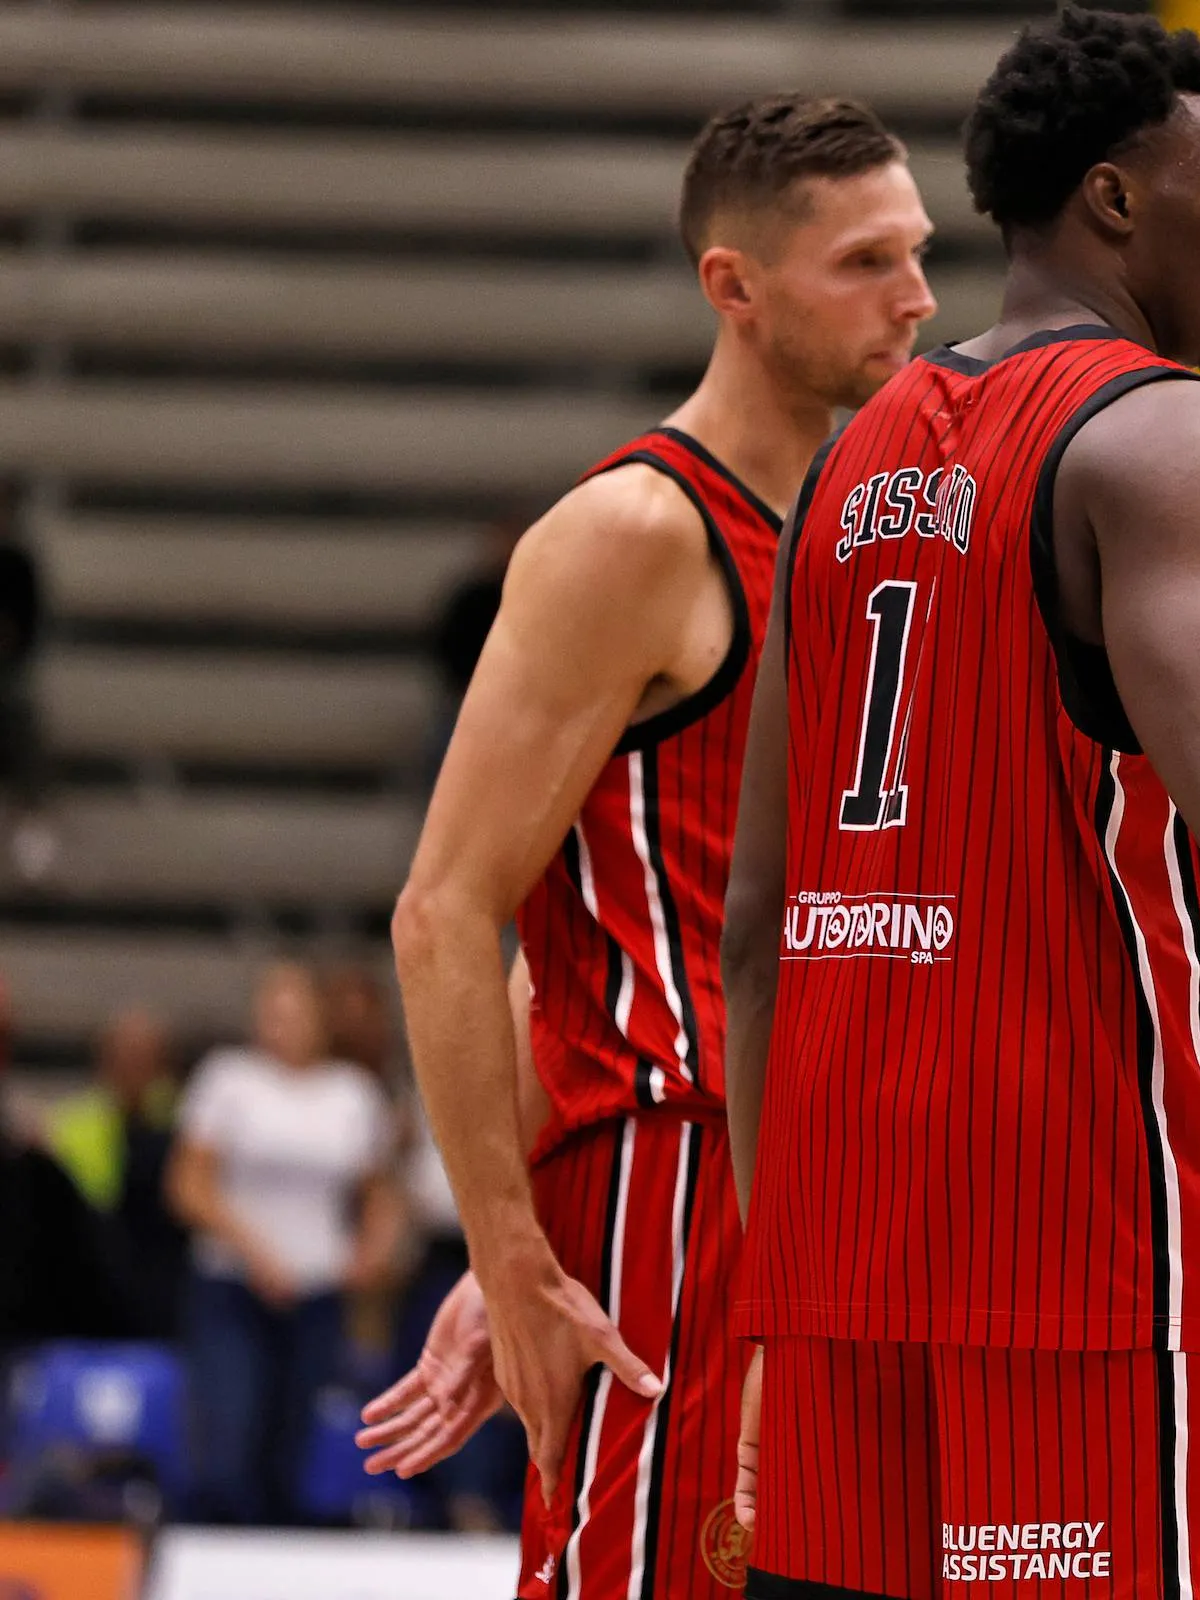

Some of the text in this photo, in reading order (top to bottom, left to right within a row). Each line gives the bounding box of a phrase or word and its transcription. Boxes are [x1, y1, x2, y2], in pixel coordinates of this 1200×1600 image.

[798, 891, 842, 905] GRUPPO
[910, 951, 934, 964] SPA
[942, 1521, 1105, 1552] BLUENERGY
[942, 1551, 1112, 1581] ASSISTANCE
